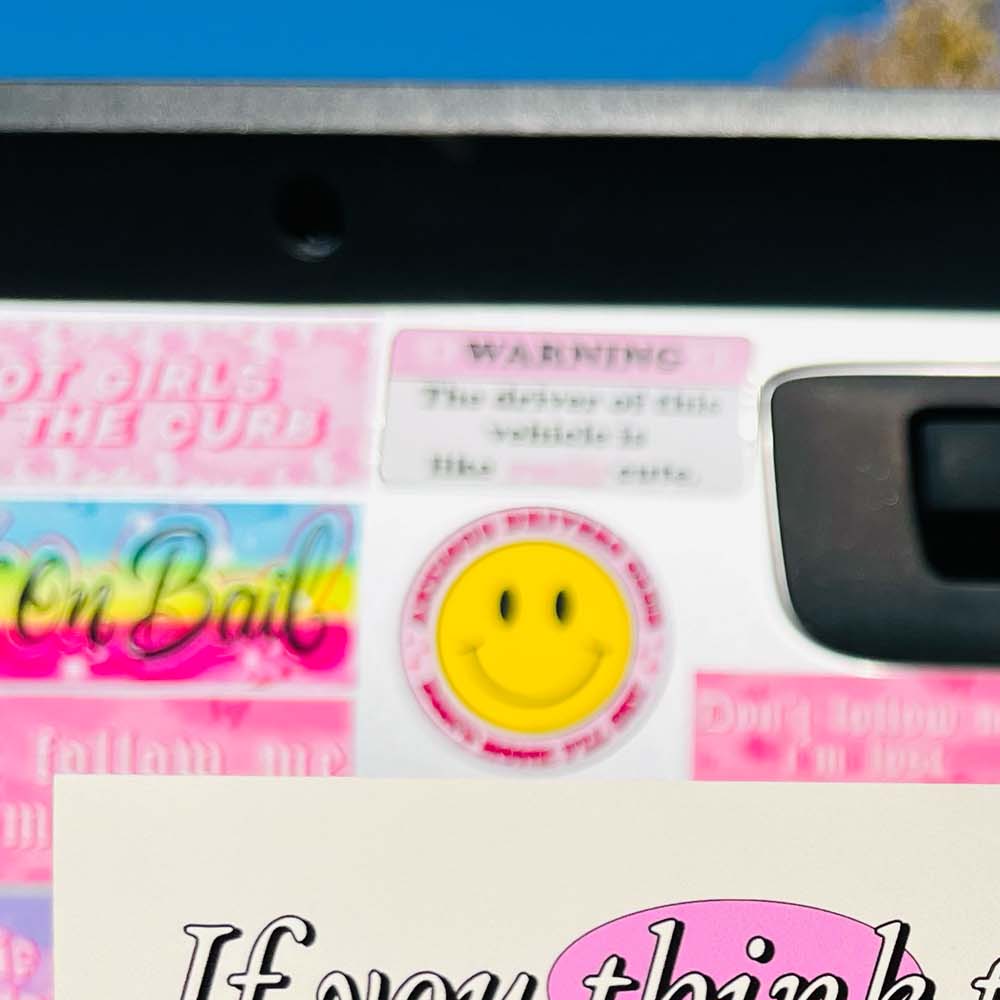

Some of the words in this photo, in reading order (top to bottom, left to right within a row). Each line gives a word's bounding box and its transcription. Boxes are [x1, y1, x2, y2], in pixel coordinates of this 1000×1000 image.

[95, 352, 286, 402] GIRLS
[466, 338, 685, 371] WARNING
[24, 402, 142, 448] THE
[155, 403, 330, 452] CURB
